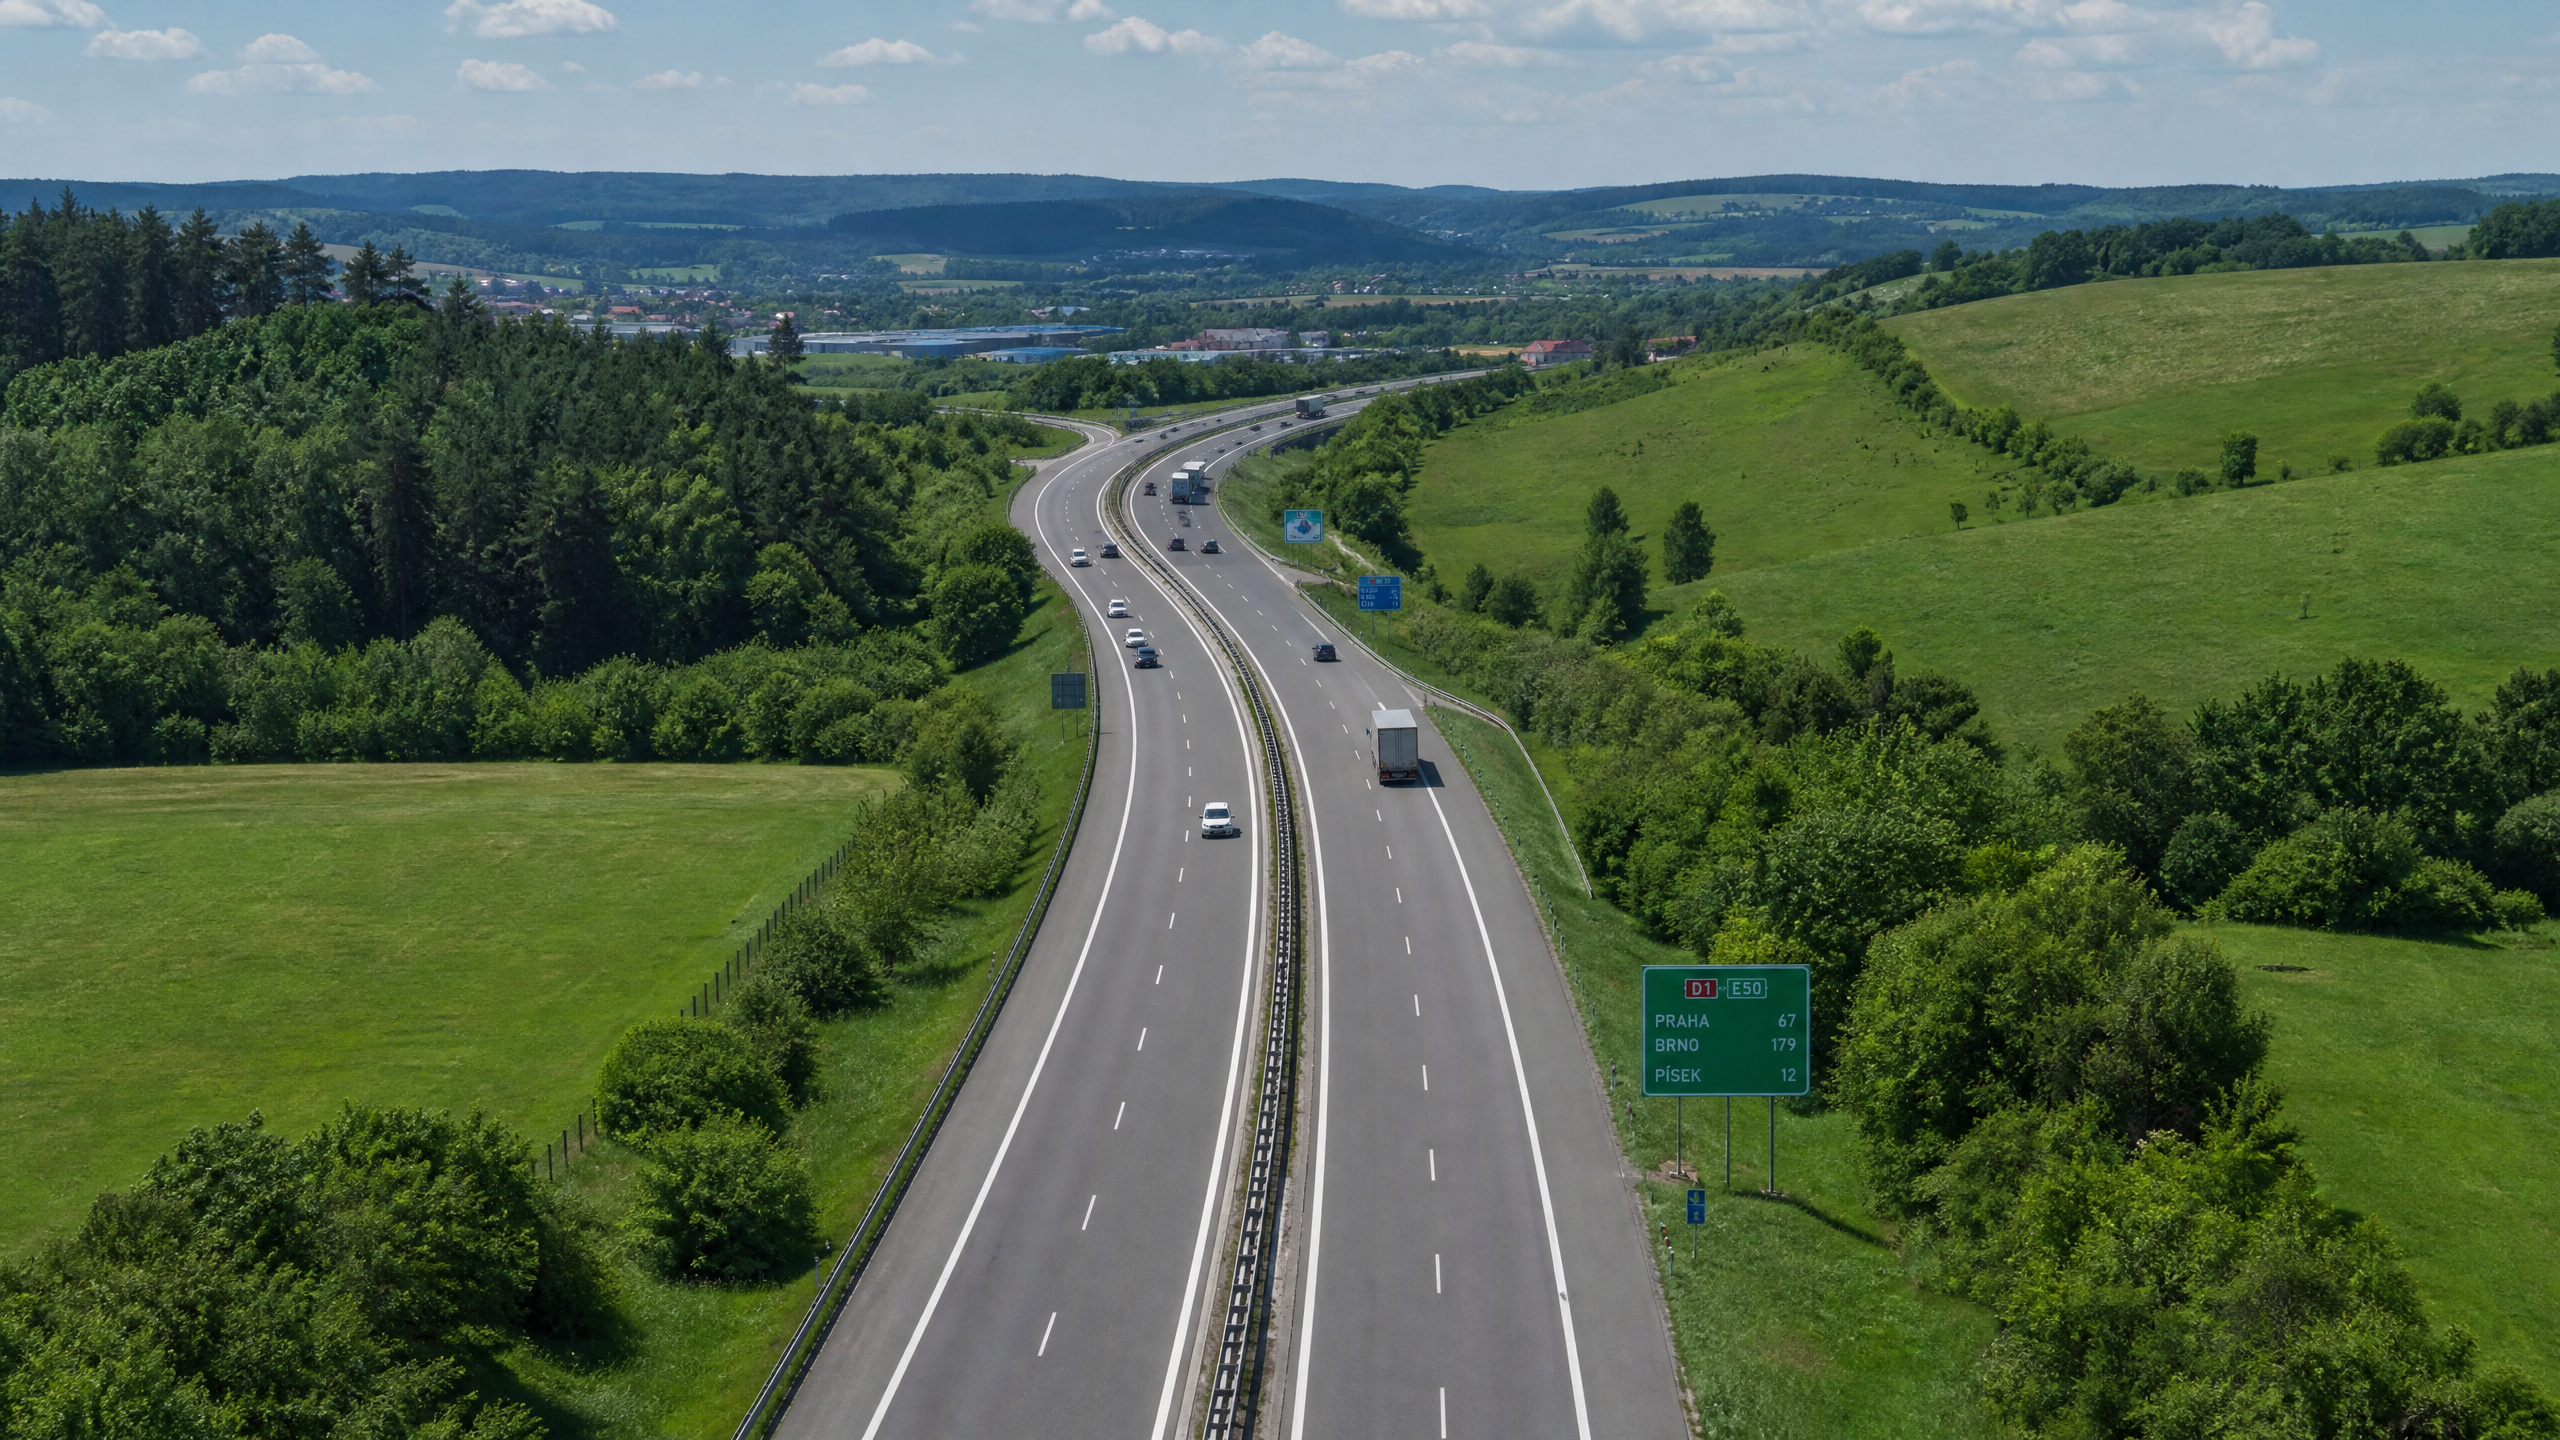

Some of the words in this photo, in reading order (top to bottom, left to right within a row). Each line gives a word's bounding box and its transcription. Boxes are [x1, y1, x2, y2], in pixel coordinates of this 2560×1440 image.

[1692, 981, 1711, 996] D1
[1732, 981, 1762, 995] E50
[1655, 1014, 1710, 1028] PRAHA
[1778, 1013, 1796, 1028] 67
[1655, 1038, 1699, 1052] BRNO
[1771, 1037, 1796, 1052] 179
[1655, 1065, 1701, 1082] PÍSEK
[1781, 1068, 1796, 1082] 12
